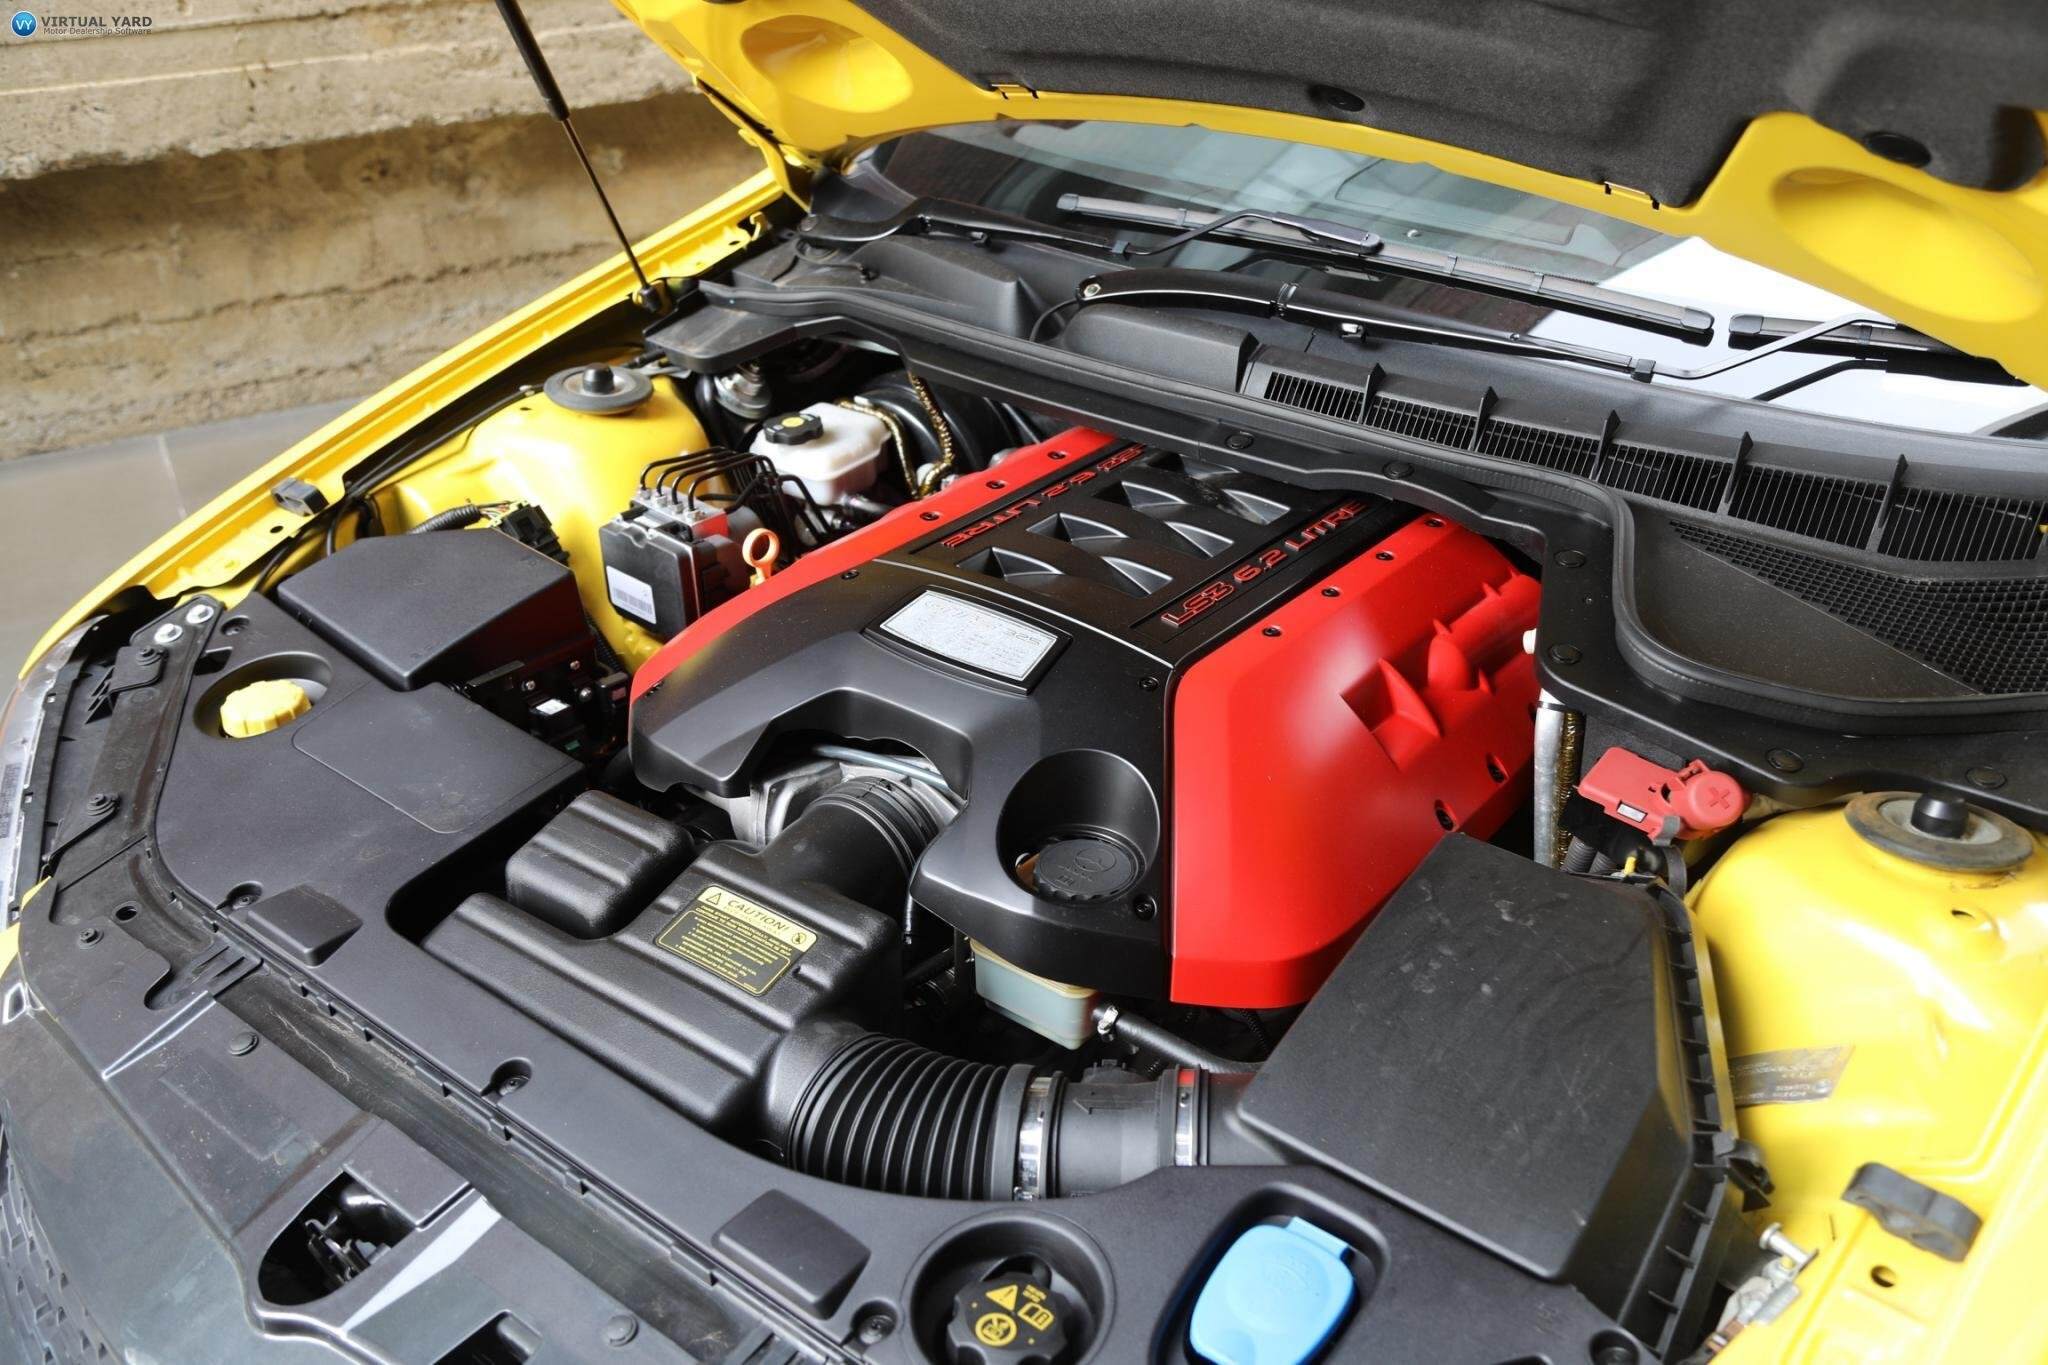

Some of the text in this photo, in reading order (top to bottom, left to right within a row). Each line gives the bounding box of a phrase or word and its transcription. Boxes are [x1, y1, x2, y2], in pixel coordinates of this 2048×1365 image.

[1161, 581, 1234, 627] LS3
[1285, 499, 1369, 551] LITRE
[727, 900, 790, 931] CAUTION!
